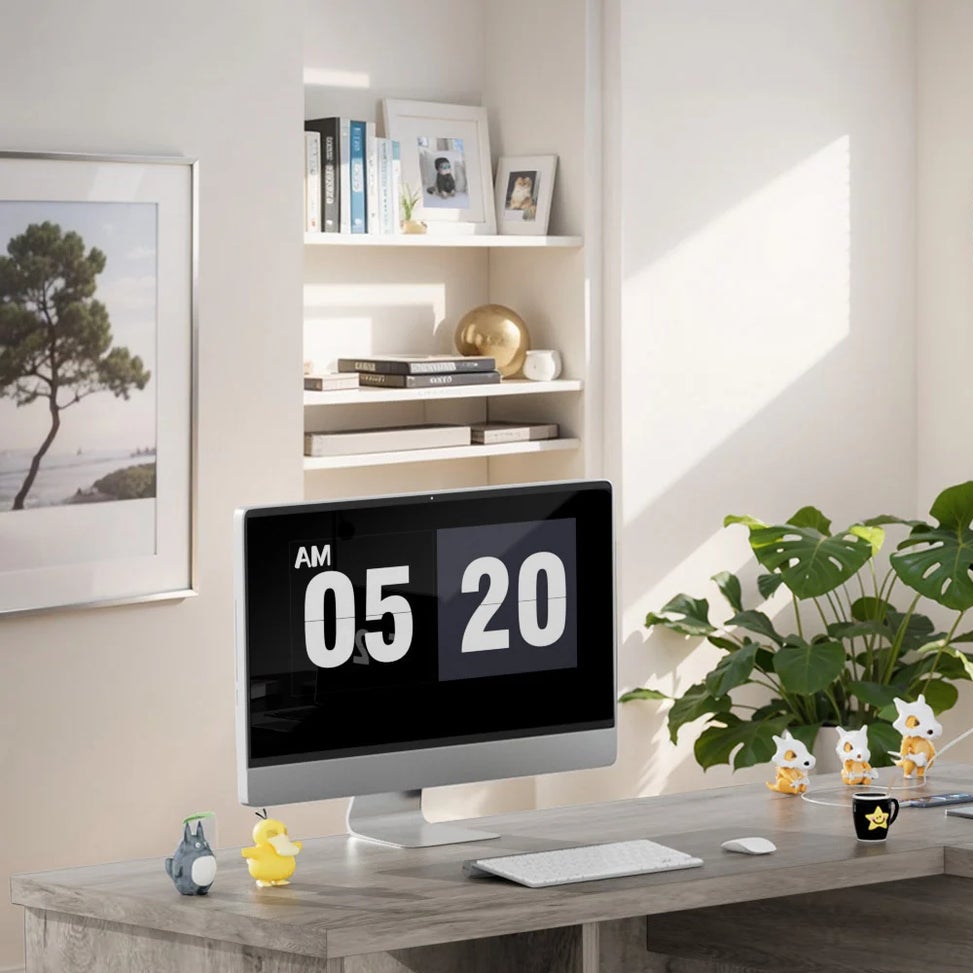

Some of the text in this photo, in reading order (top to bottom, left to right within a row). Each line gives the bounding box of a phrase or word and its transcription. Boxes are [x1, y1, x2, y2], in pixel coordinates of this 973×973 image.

[294, 544, 331, 568] AM
[304, 551, 567, 668] 05 20
